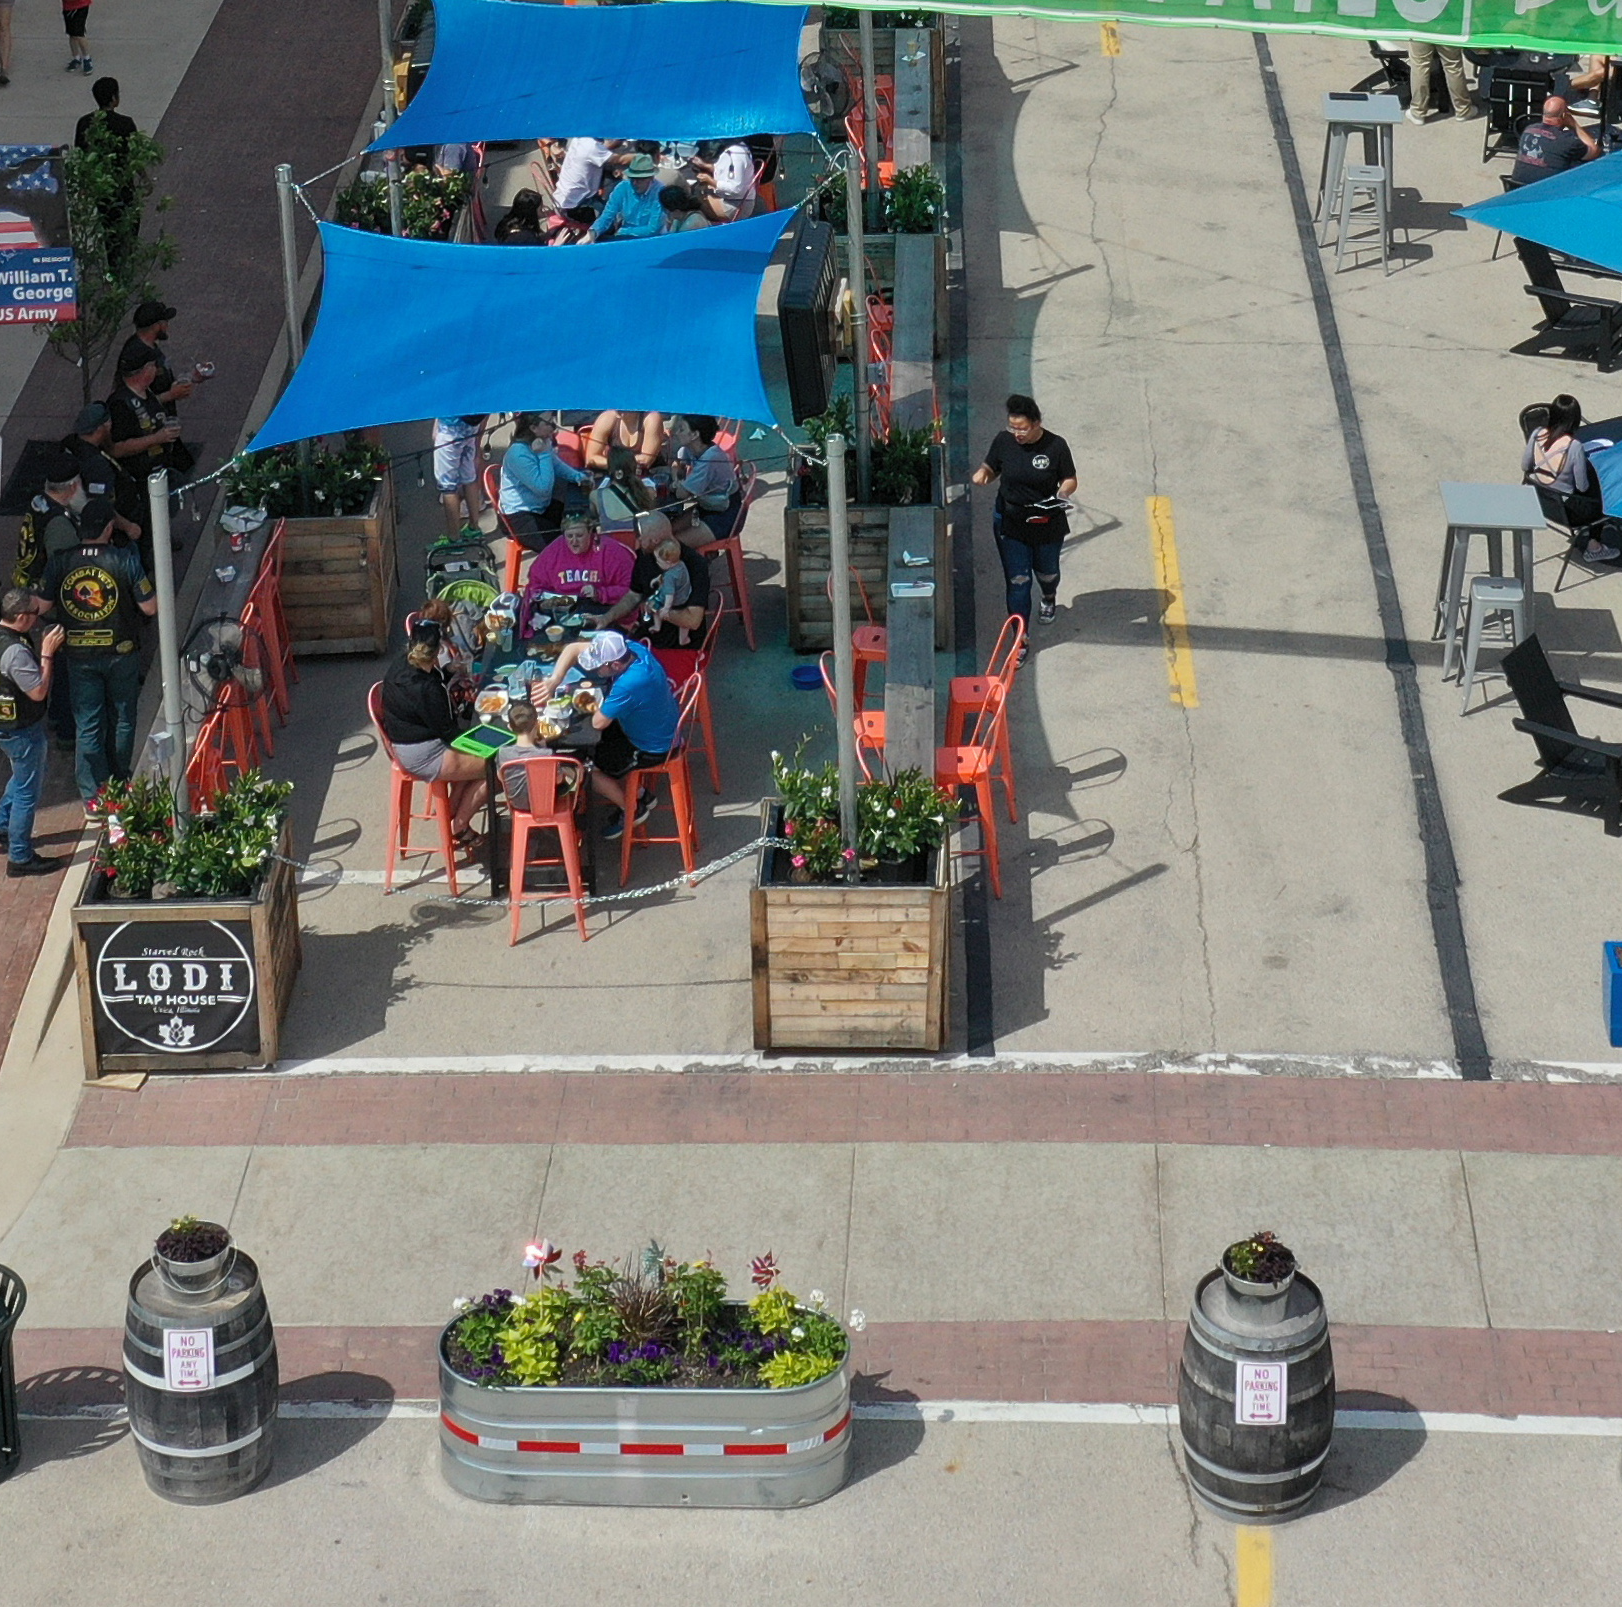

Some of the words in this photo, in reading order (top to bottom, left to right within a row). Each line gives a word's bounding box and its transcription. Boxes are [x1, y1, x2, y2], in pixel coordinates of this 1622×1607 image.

[57, 268, 73, 283] T.
[12, 286, 73, 303] George
[17, 306, 58, 322] Army
[63, 568, 96, 591] COMBAT
[97, 569, 114, 590] VETS
[65, 594, 116, 621] ASSOCIATION
[141, 946, 181, 958] Starved
[180, 946, 207, 958] Rock
[113, 962, 234, 992] LODI
[136, 994, 163, 1006] TAP
[166, 994, 217, 1006] HOUSE
[180, 1335, 195, 1347] NO
[171, 1347, 206, 1359] PARKING
[180, 1360, 198, 1368] ANY
[180, 1369, 198, 1378] TIME
[1254, 1368, 1270, 1380] NO
[1244, 1380, 1279, 1392] PARKING
[1253, 1393, 1270, 1402] ANY
[1252, 1402, 1270, 1411] TIME
